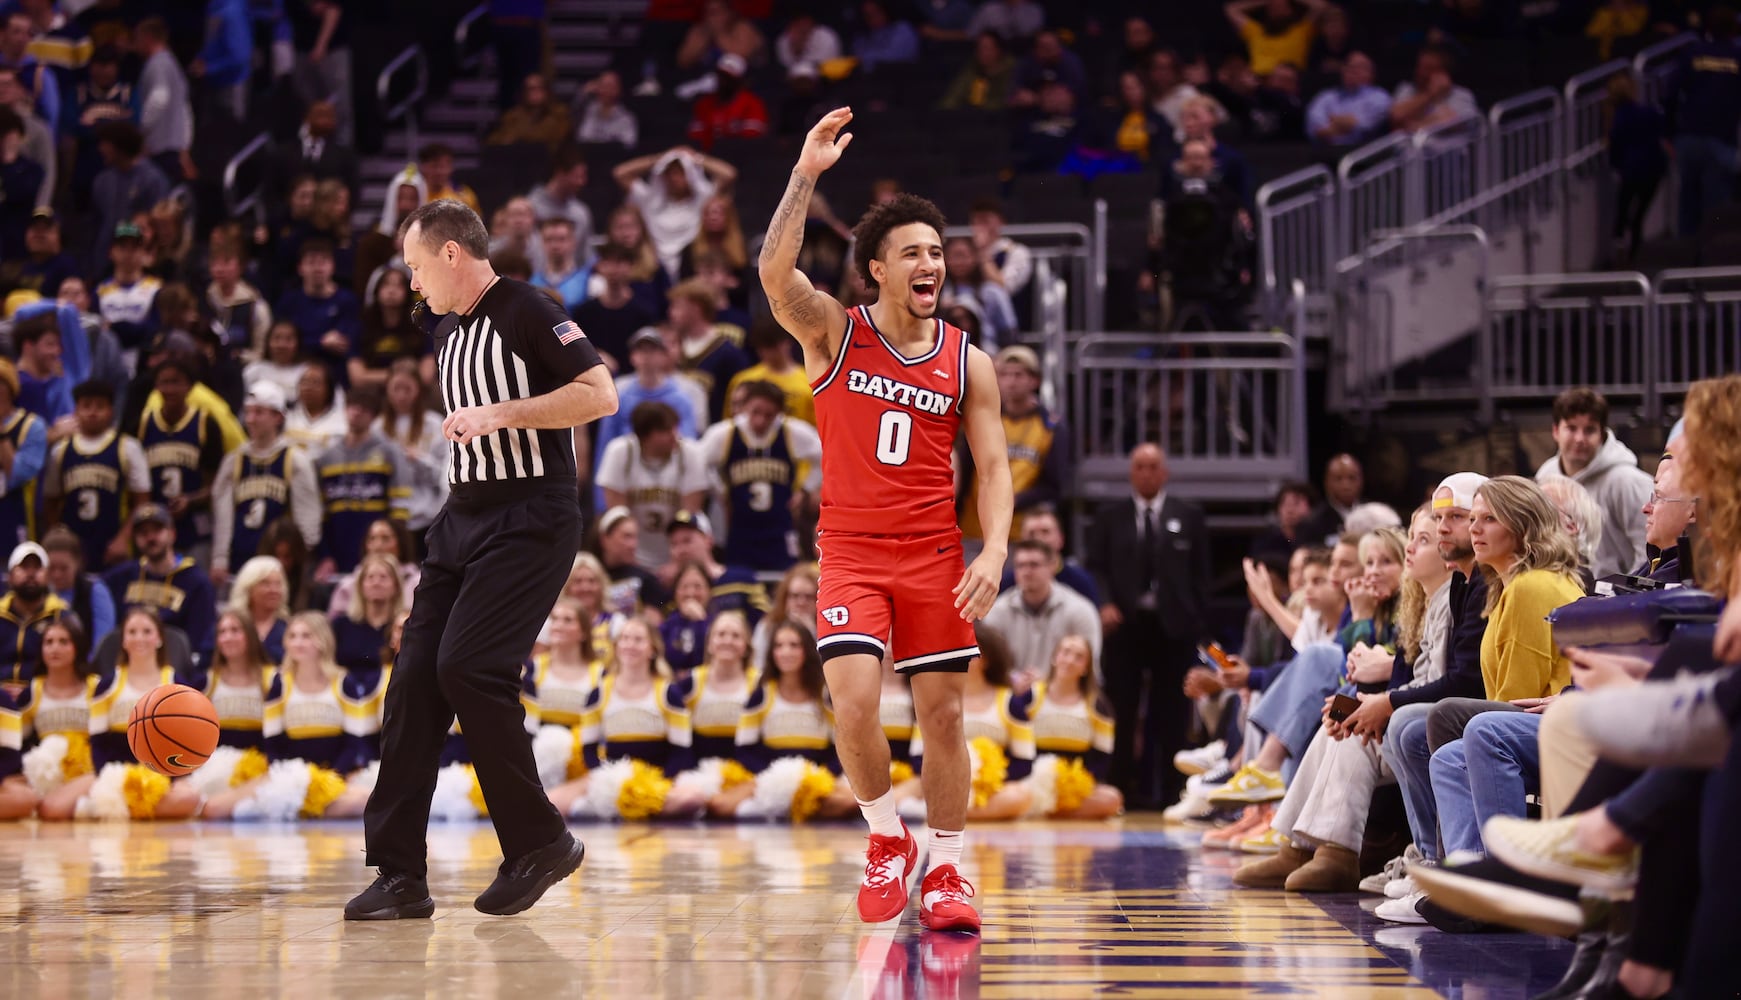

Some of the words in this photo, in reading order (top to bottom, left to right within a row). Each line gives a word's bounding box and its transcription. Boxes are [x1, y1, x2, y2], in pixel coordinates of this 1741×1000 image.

[847, 368, 954, 416] DAYTON
[876, 410, 913, 466] 0
[161, 466, 181, 498] 3
[748, 482, 773, 512] 3
[78, 489, 99, 520] 3
[243, 499, 267, 529] 3
